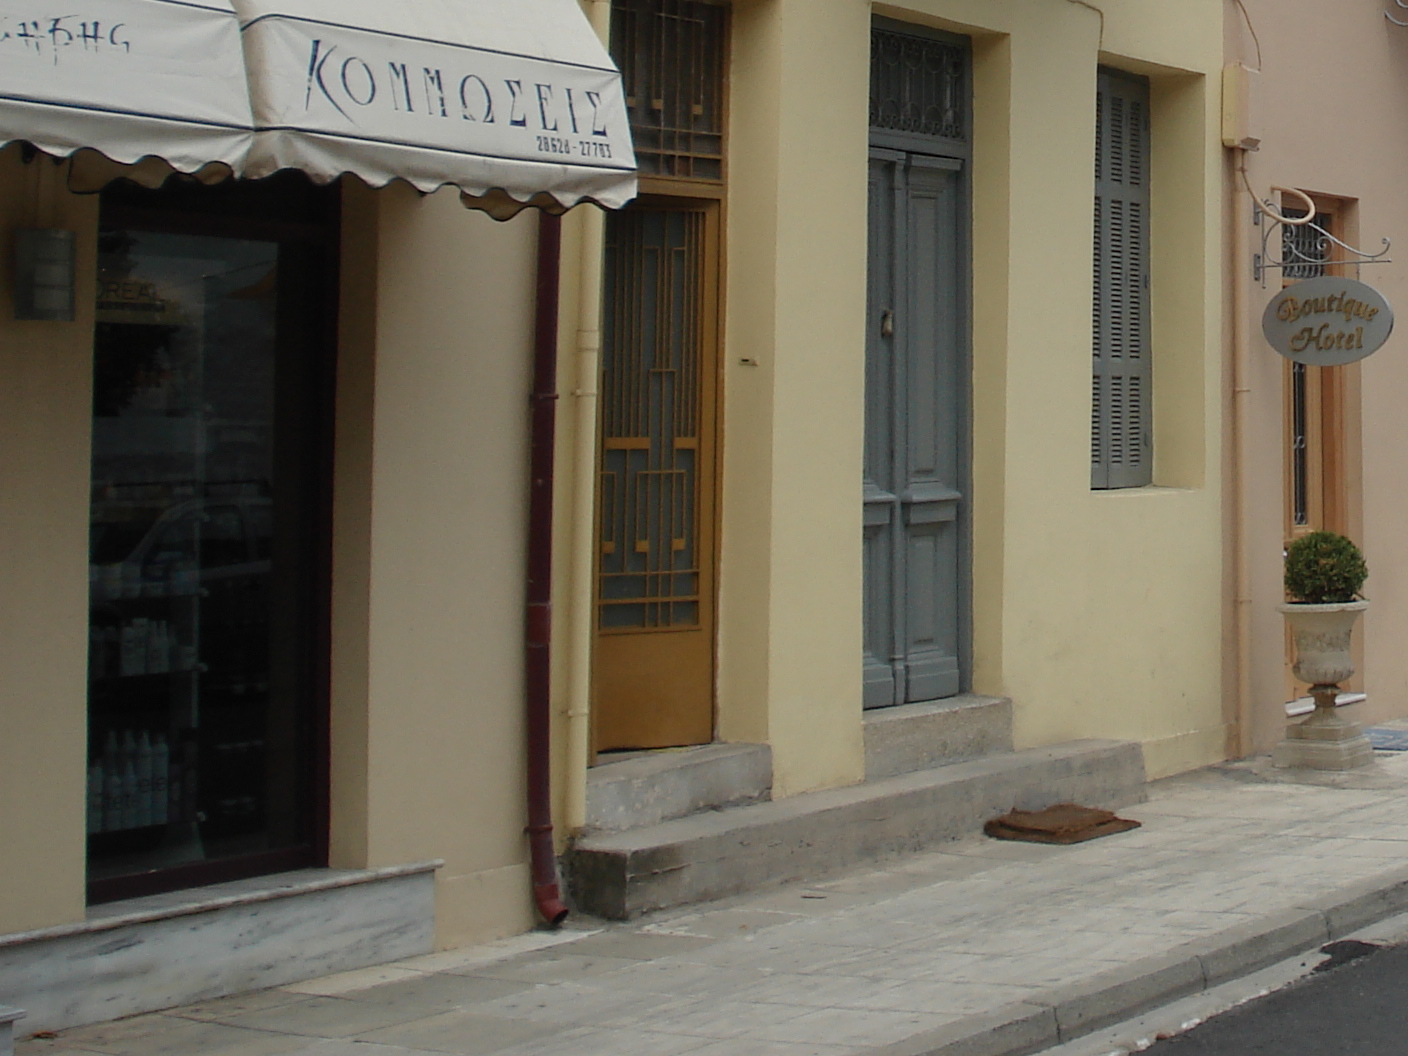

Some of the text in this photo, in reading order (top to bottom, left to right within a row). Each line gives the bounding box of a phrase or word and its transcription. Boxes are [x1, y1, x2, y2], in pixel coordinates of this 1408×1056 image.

[305, 39, 608, 137] ΚΟΜΜΩΣΕΙΣ
[1276, 290, 1380, 324] Boutique
[1289, 322, 1364, 353] Hotel
